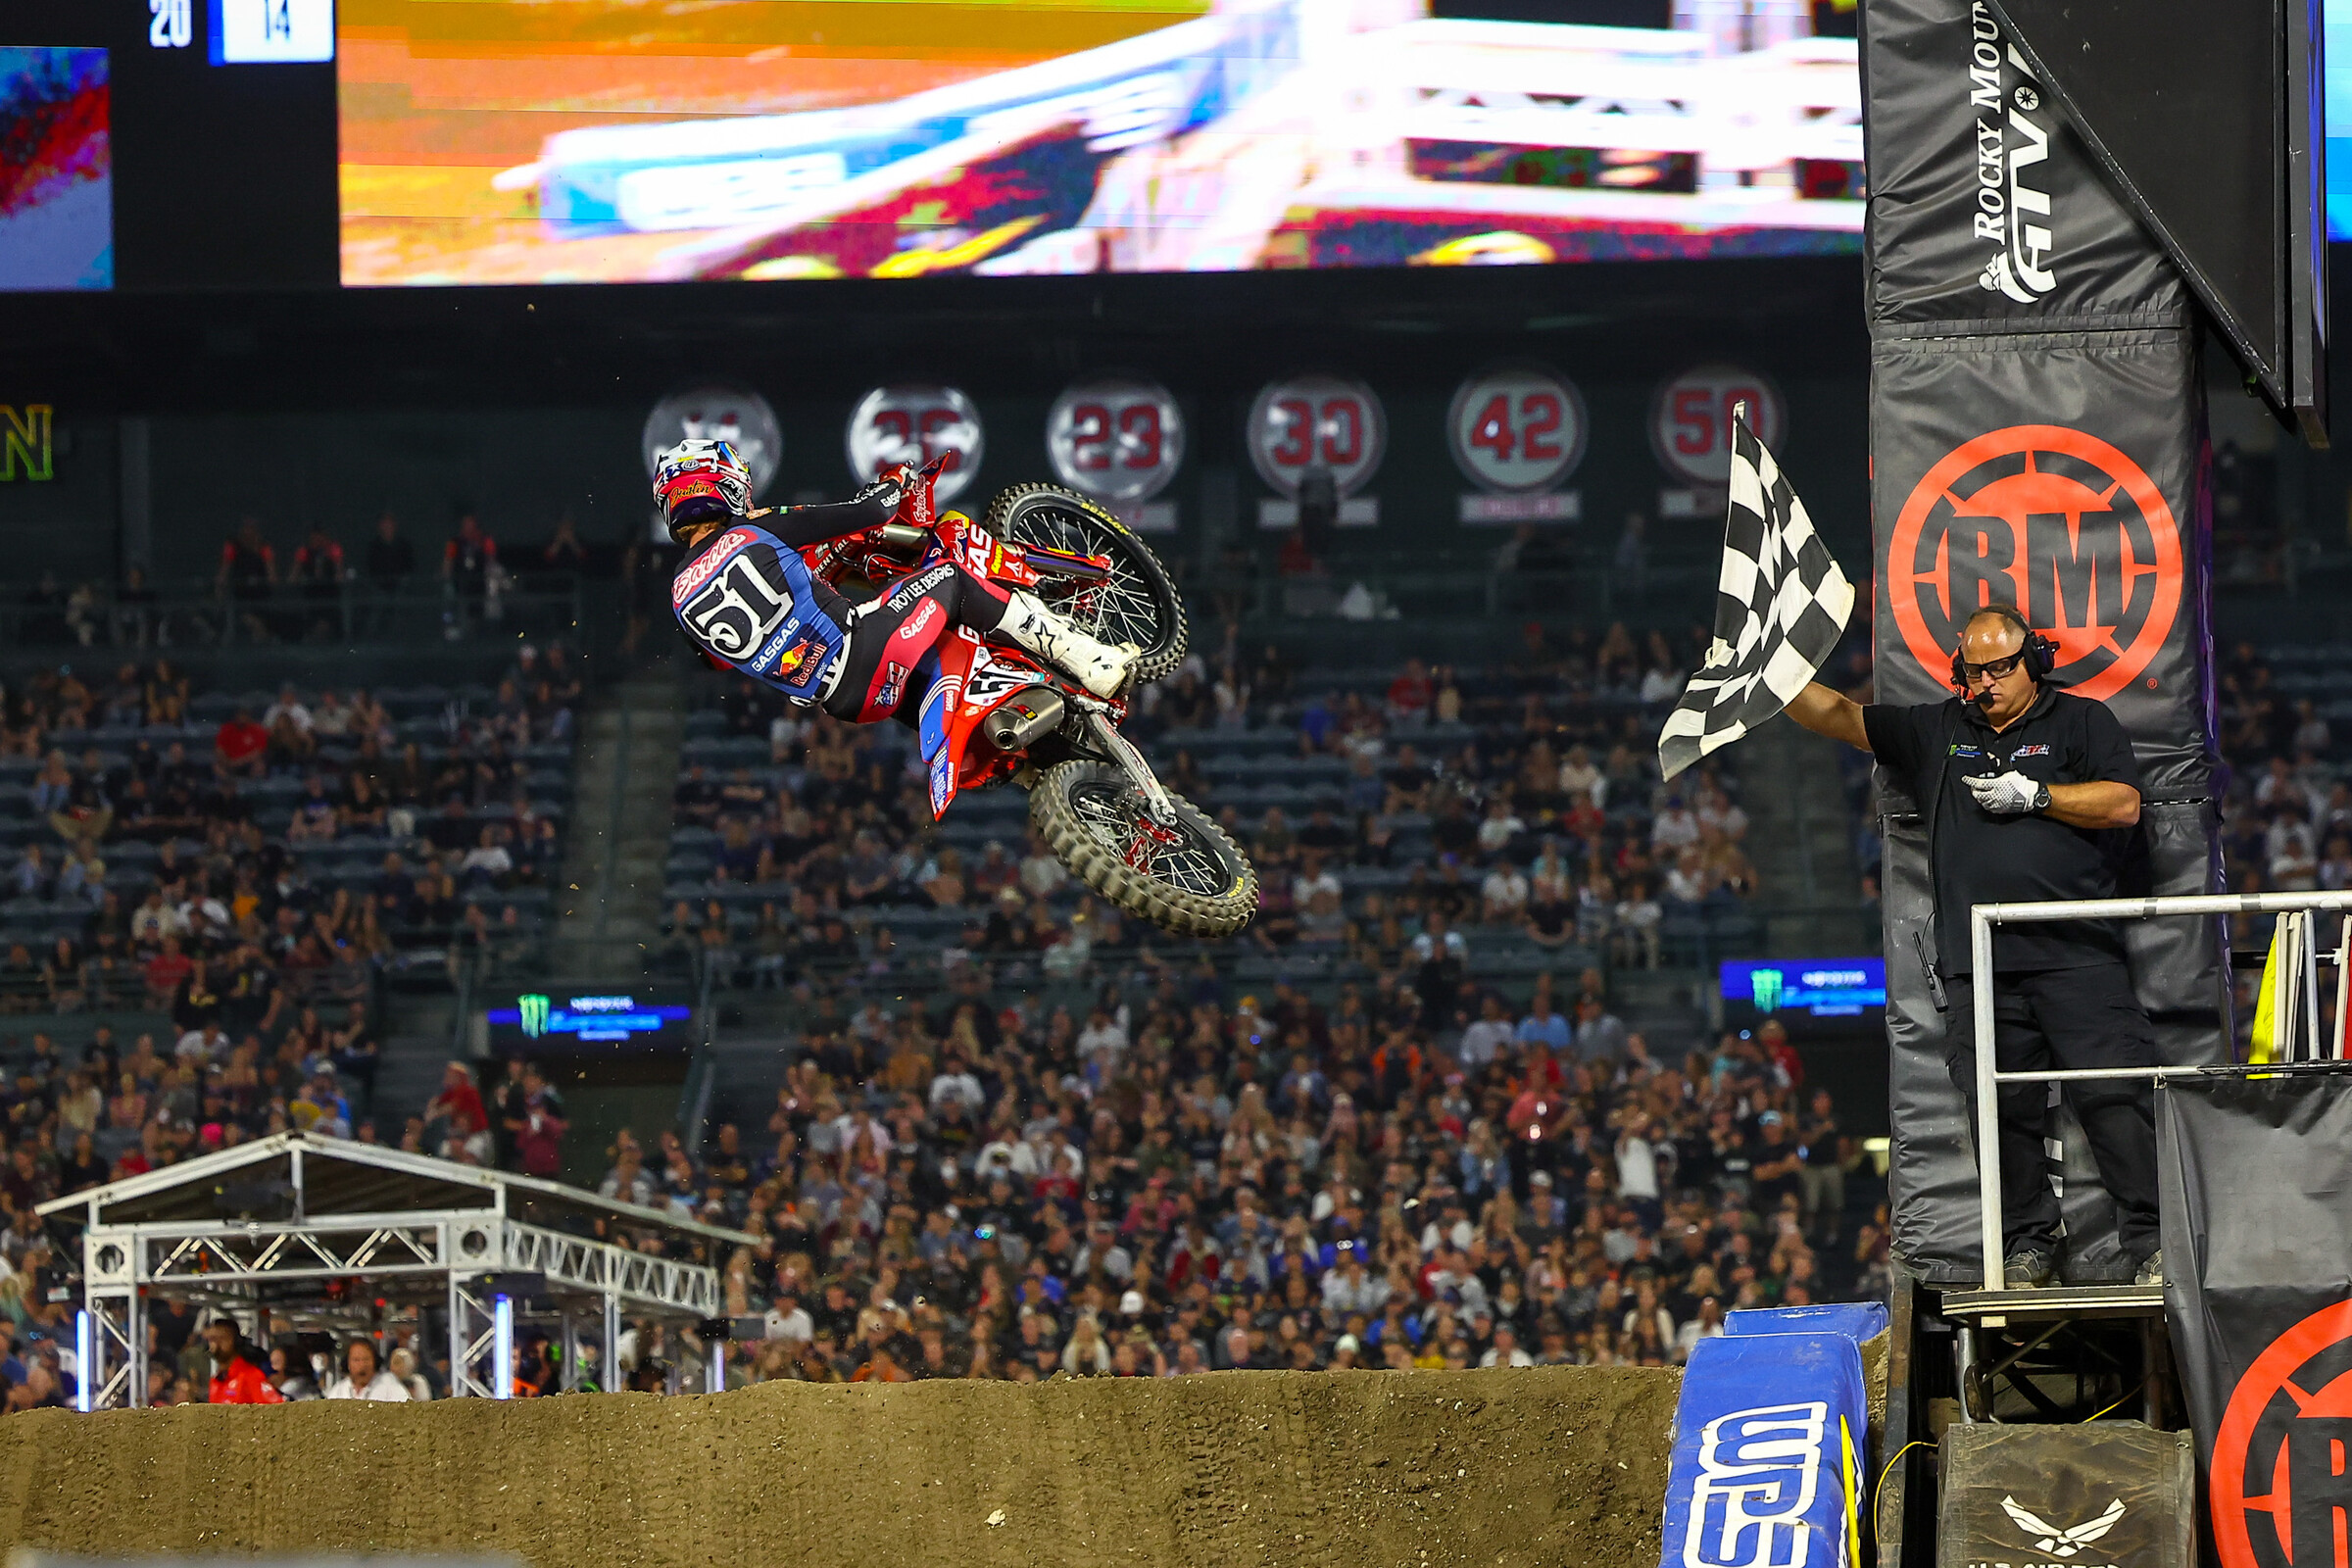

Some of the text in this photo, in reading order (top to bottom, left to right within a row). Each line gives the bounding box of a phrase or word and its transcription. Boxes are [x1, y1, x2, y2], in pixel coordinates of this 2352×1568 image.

[149, 0, 192, 48] 20
[1974, 118, 2007, 245] ROCKY
[1274, 398, 1362, 466] 30
[1472, 393, 1561, 462] 42
[669, 478, 715, 509] Justin
[672, 531, 748, 606] Barcia
[812, 538, 851, 578] RENTAL
[1947, 510, 2124, 630] RM
[680, 554, 795, 660] 51
[886, 564, 956, 613] TROY LEE DESIGNS
[751, 616, 801, 673] GASGAS
[900, 599, 938, 640] GASGAS
[789, 642, 828, 687] Red Bull
